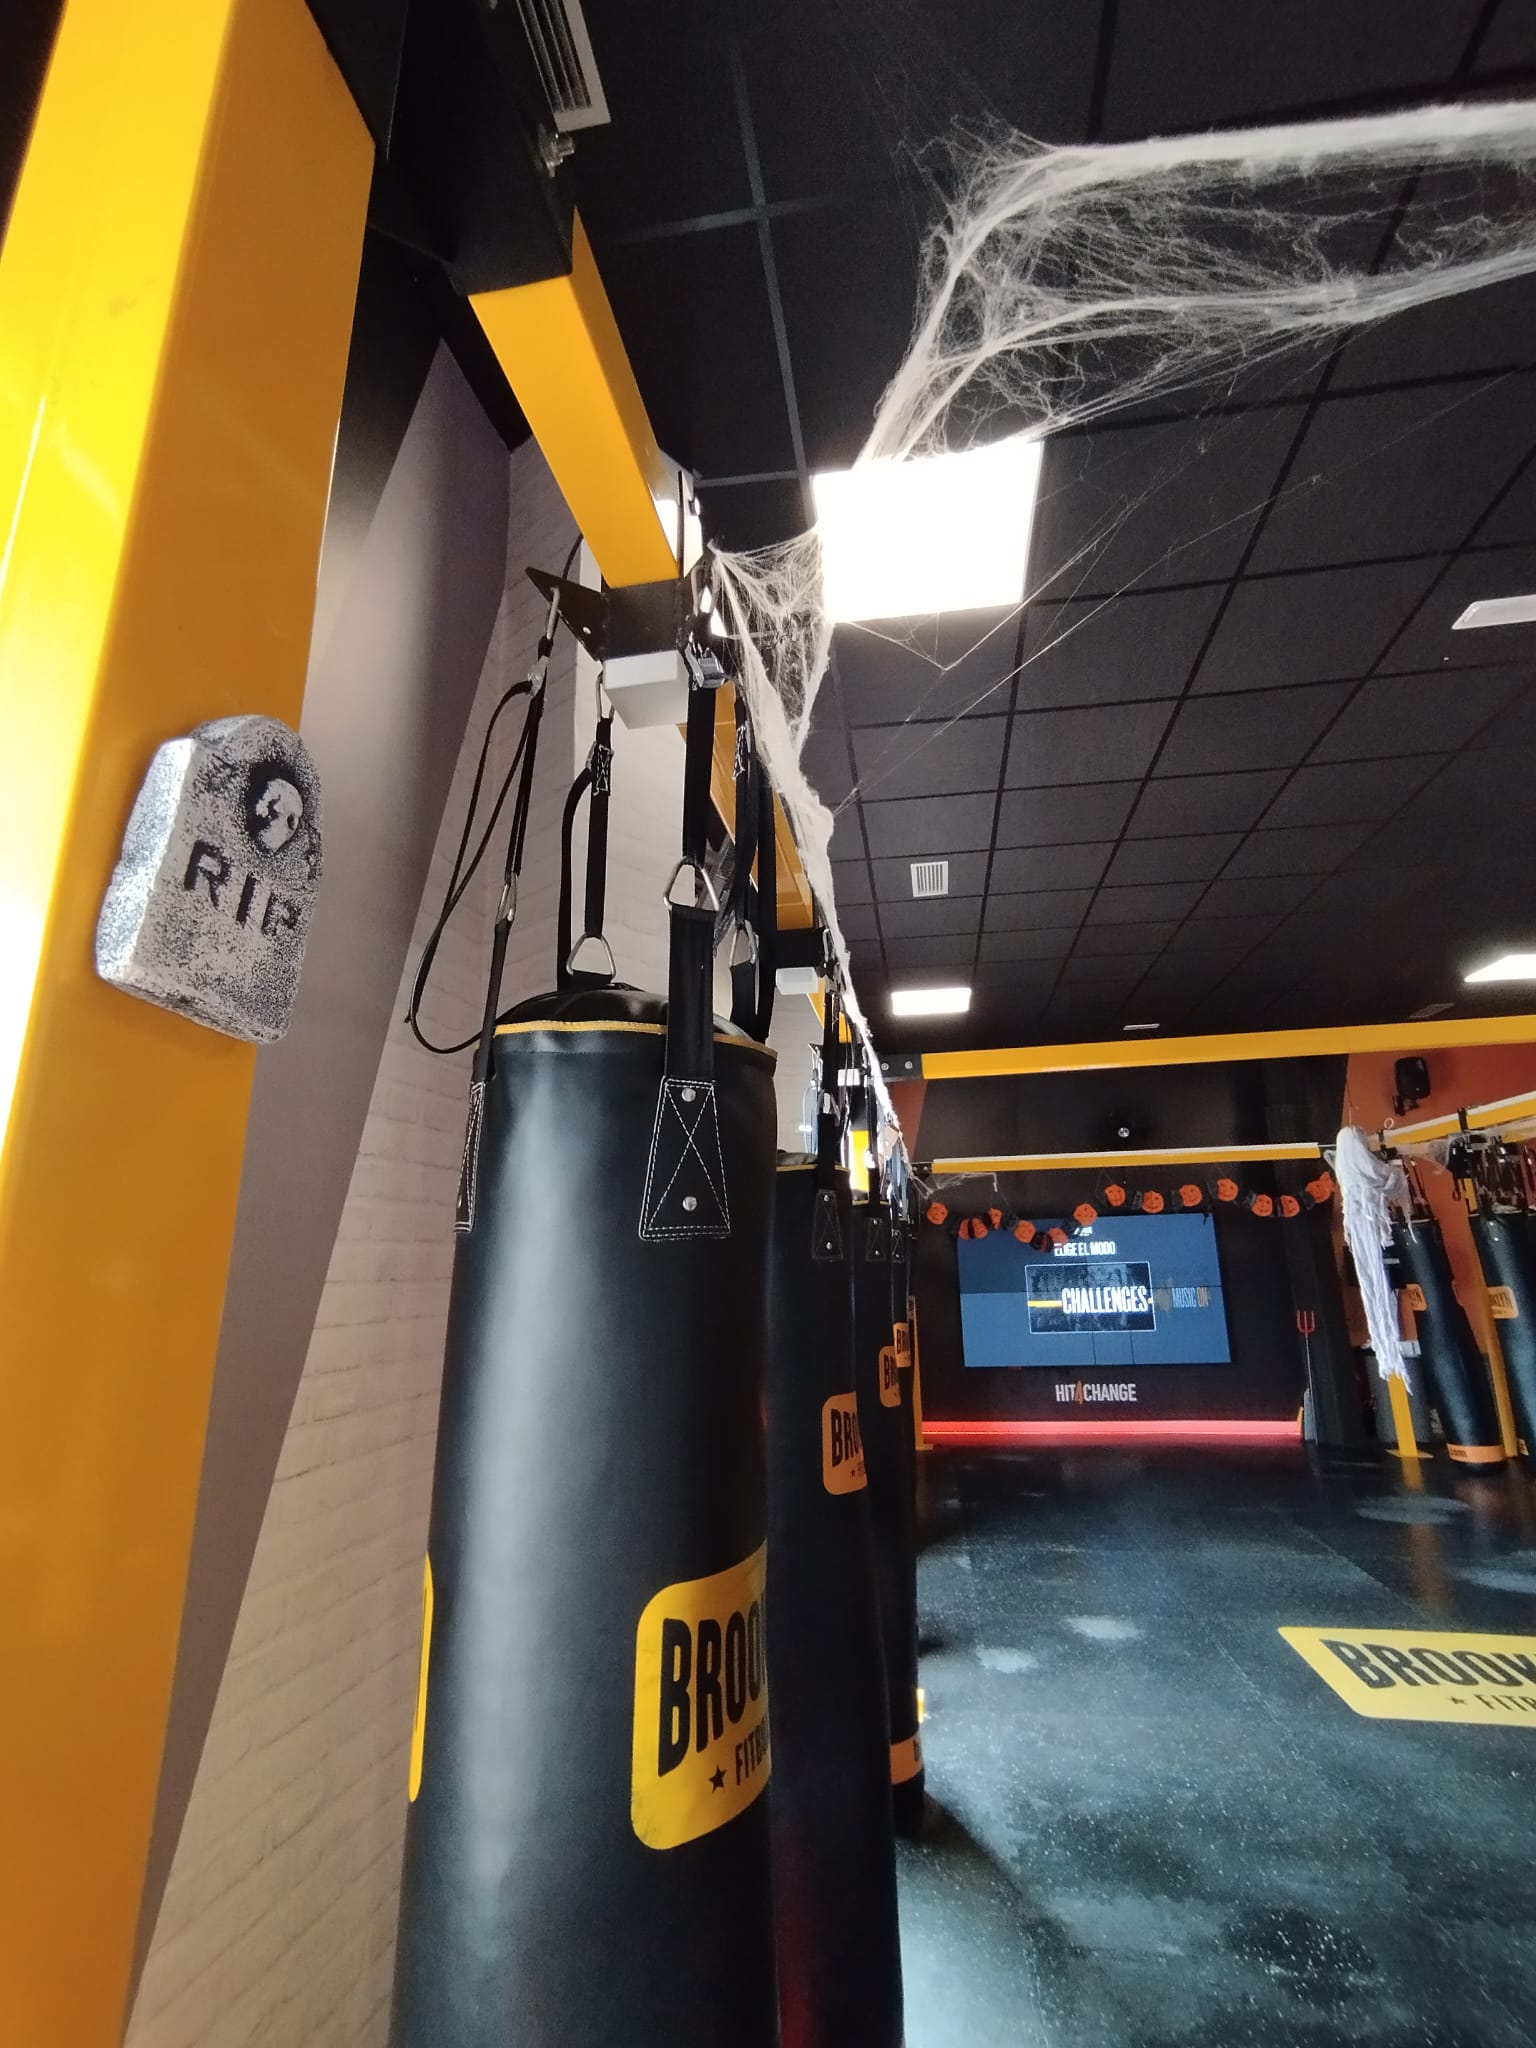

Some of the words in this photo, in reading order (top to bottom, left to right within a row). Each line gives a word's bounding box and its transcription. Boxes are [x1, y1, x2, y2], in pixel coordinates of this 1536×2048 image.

[184, 839, 301, 936] RIP
[1078, 1242, 1091, 1256] EL
[1090, 1240, 1116, 1256] MODO
[1061, 1285, 1149, 1314] CHALLENGES
[1171, 1287, 1197, 1308] MUSIC
[1196, 1286, 1209, 1307] ON
[658, 1594, 767, 1777] BROO
